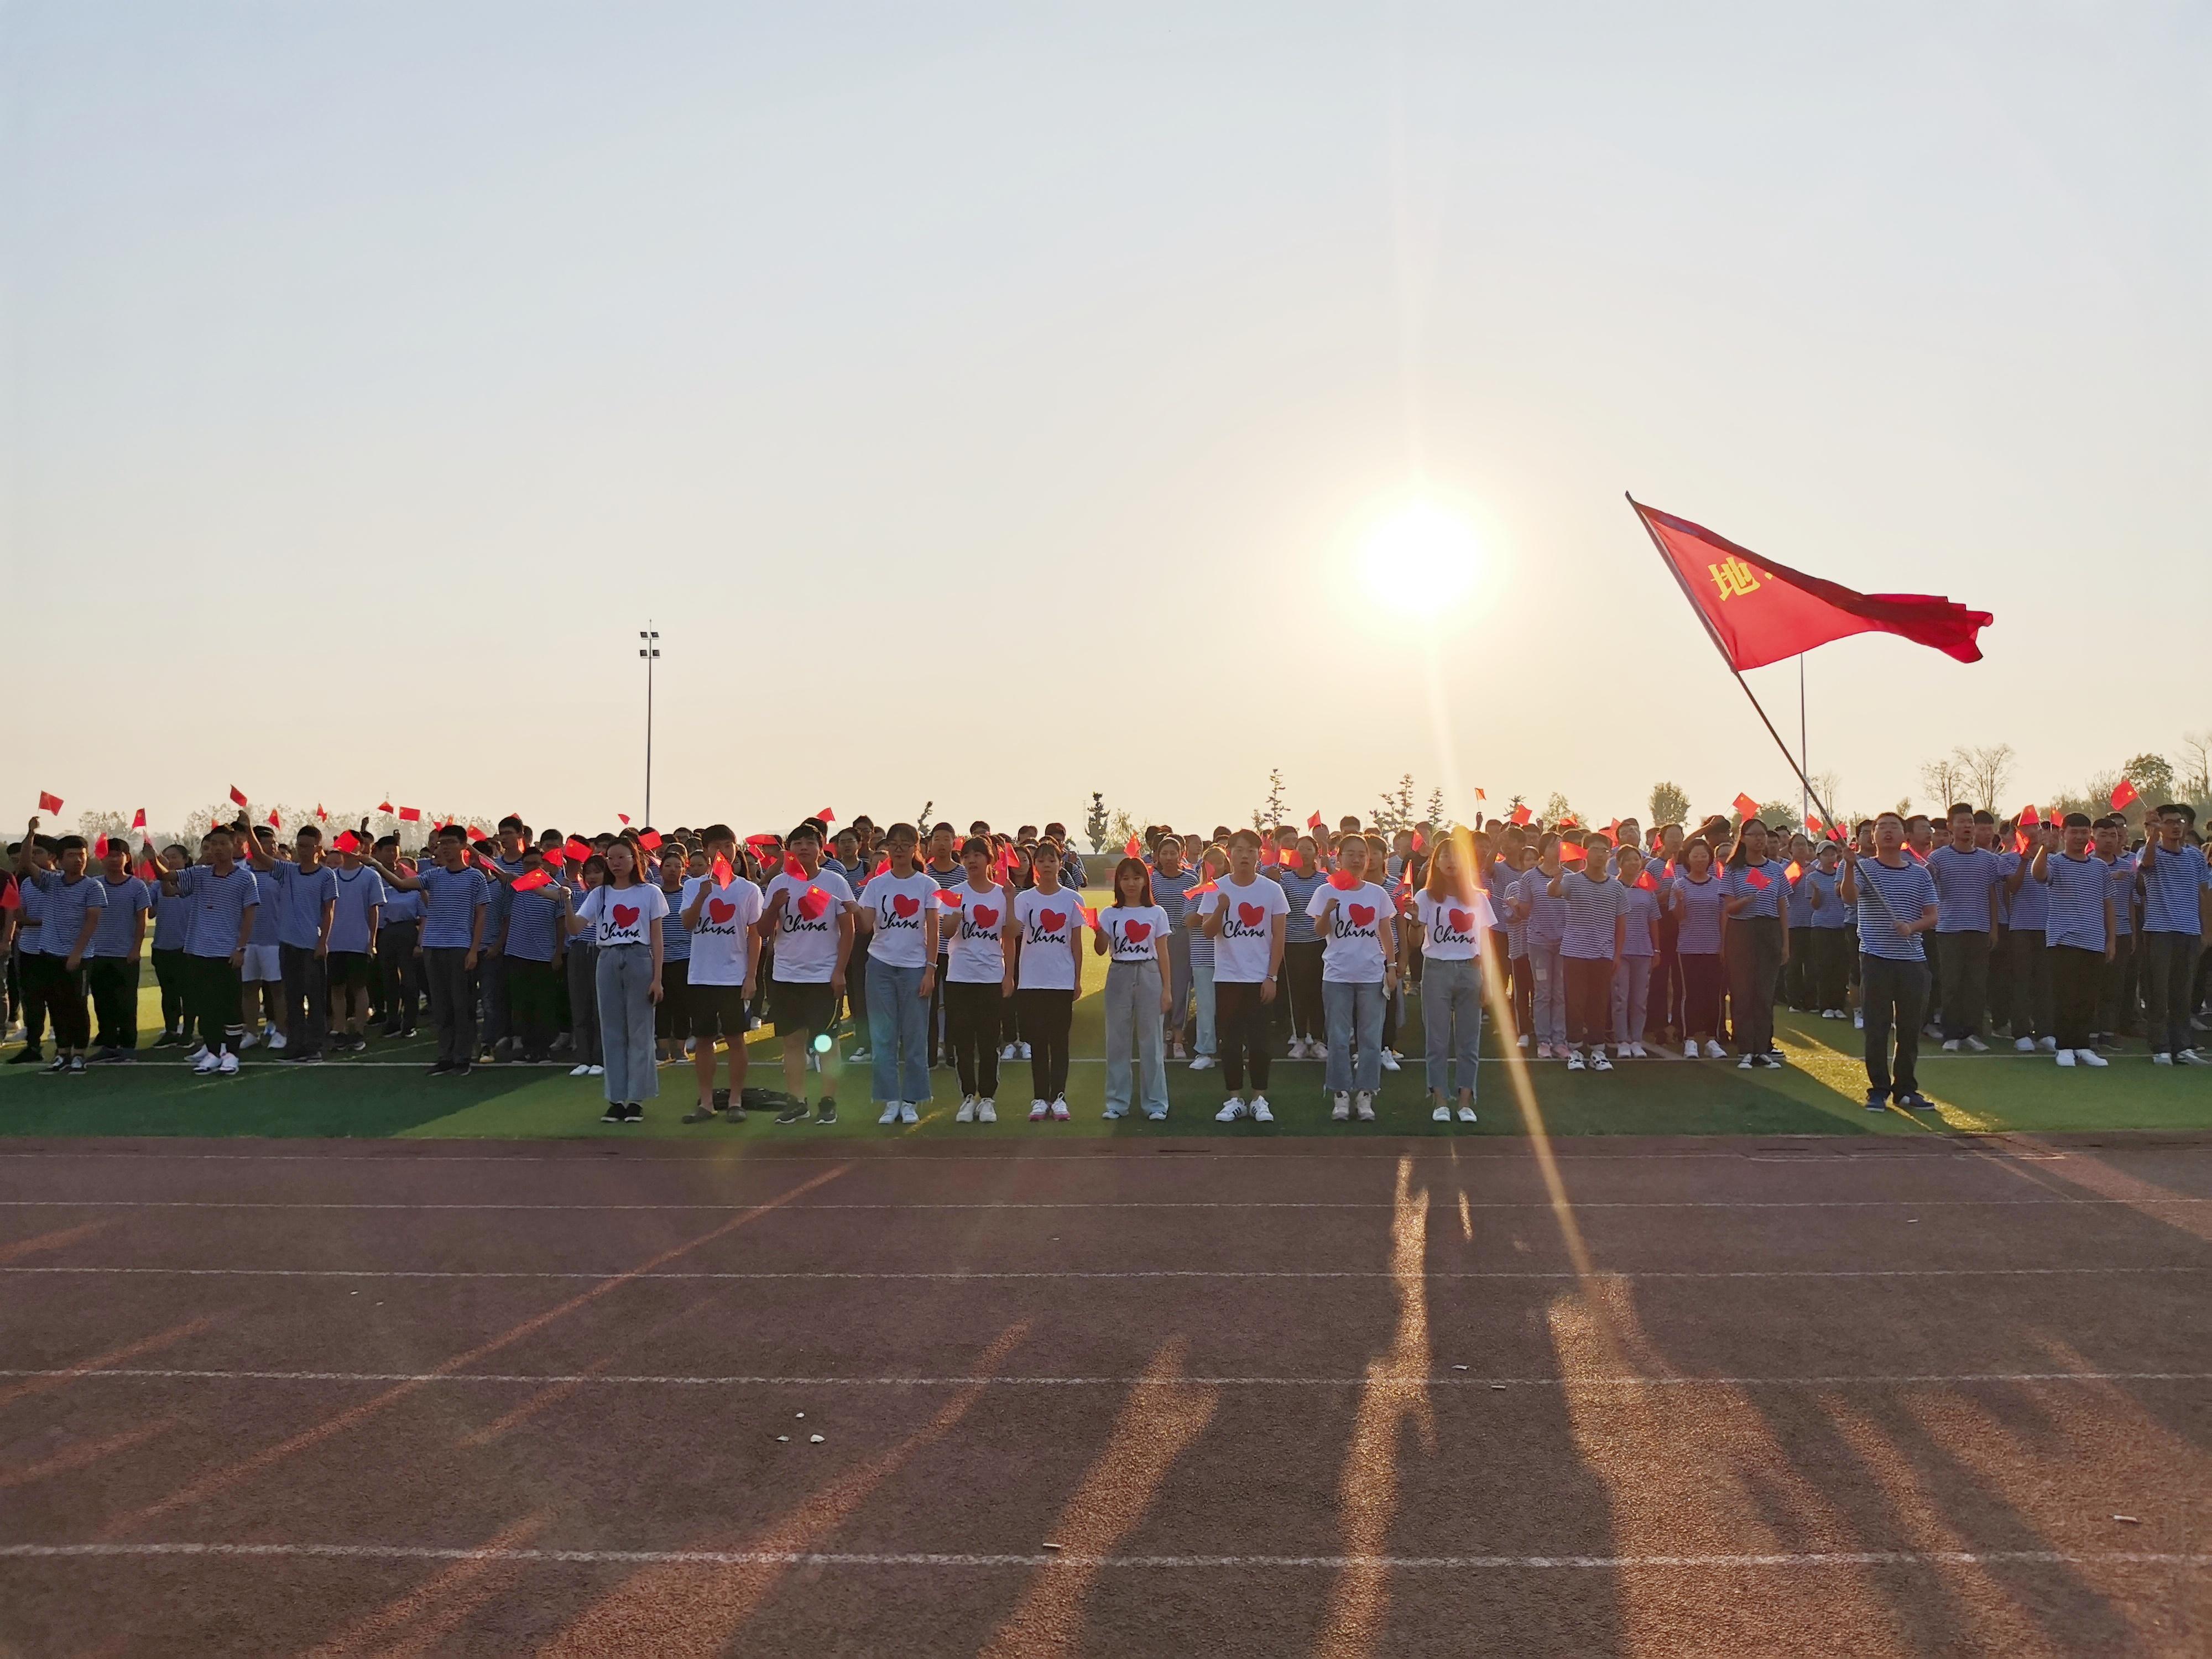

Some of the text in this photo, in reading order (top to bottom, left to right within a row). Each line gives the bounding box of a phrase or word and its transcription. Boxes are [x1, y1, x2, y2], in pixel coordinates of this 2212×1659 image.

[1708, 557, 1773, 602] 地
[600, 921, 640, 940] China
[782, 915, 827, 932] China
[962, 921, 998, 940] China
[1223, 920, 1265, 938] China
[1335, 920, 1376, 938] China
[1433, 925, 1476, 943] China
